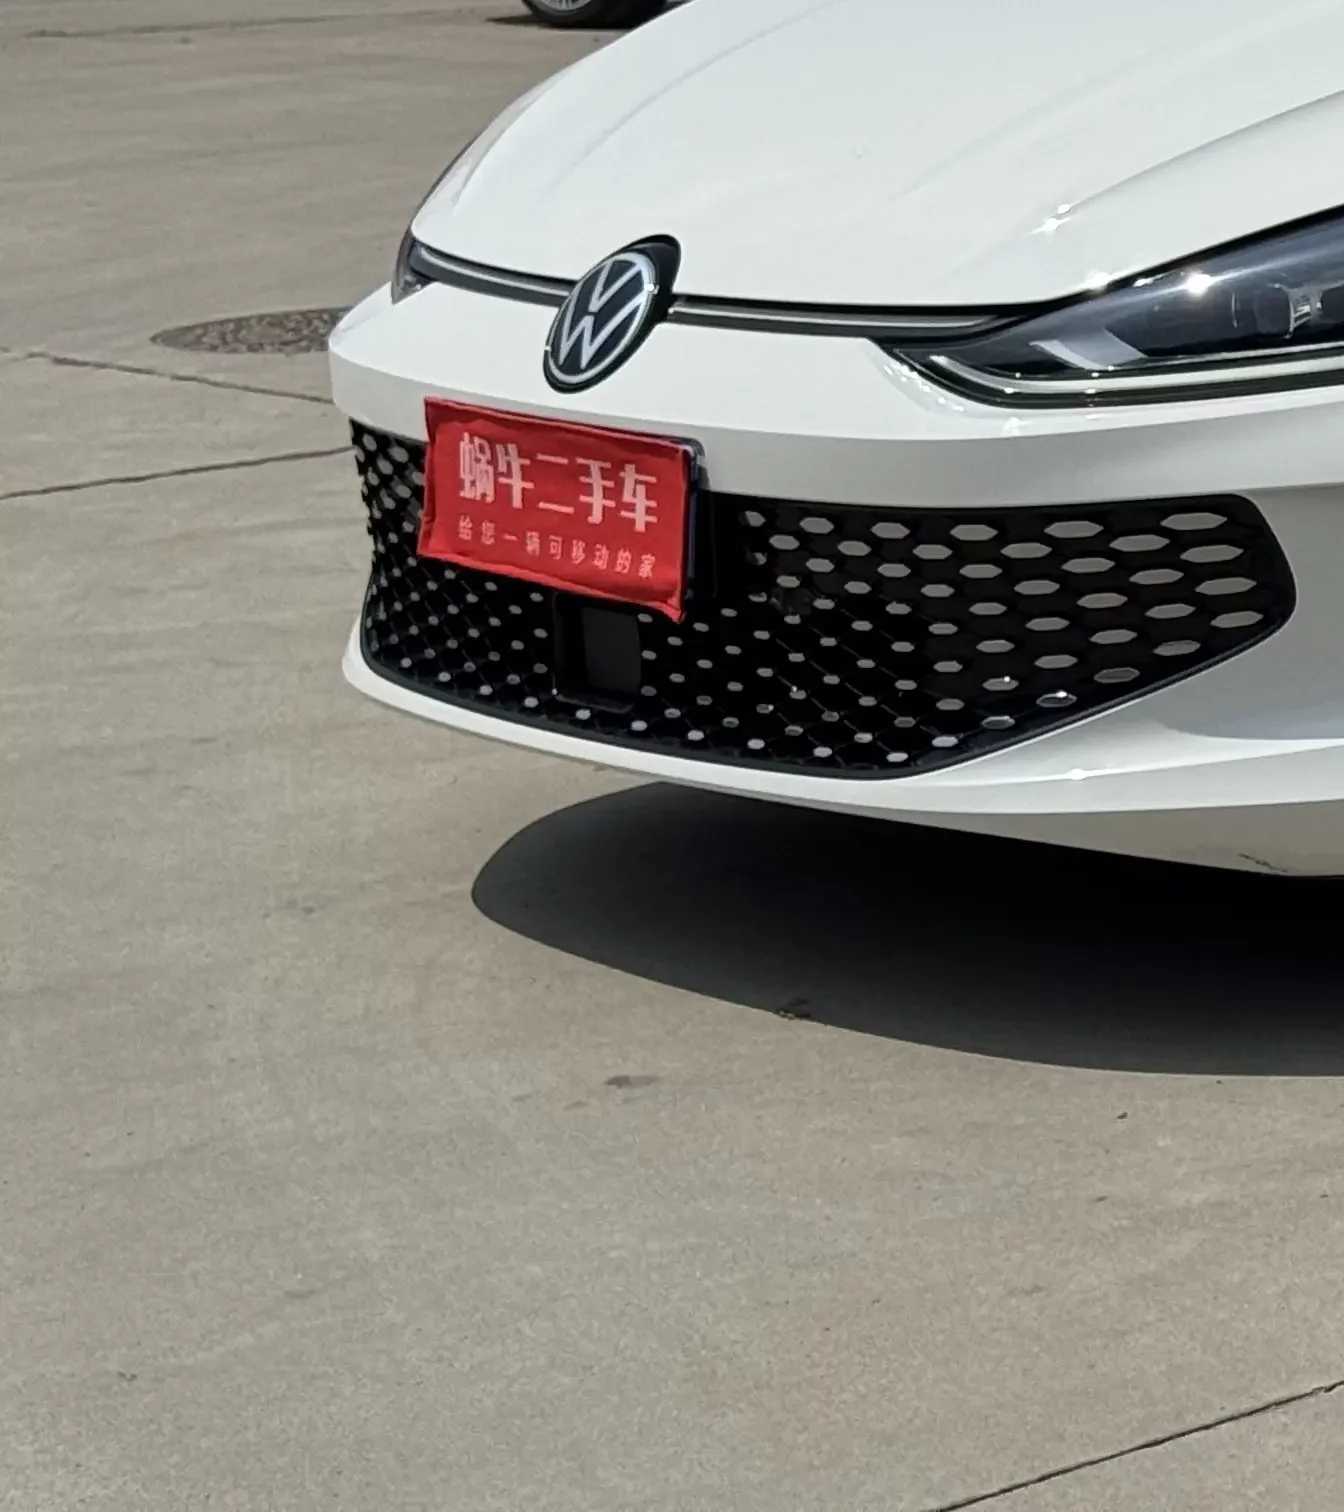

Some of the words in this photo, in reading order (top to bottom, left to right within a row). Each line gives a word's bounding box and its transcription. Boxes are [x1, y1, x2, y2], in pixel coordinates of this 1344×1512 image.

[459, 432, 658, 533] 蜗牛二手车
[458, 515, 656, 578] 给您一辆可移动的家
